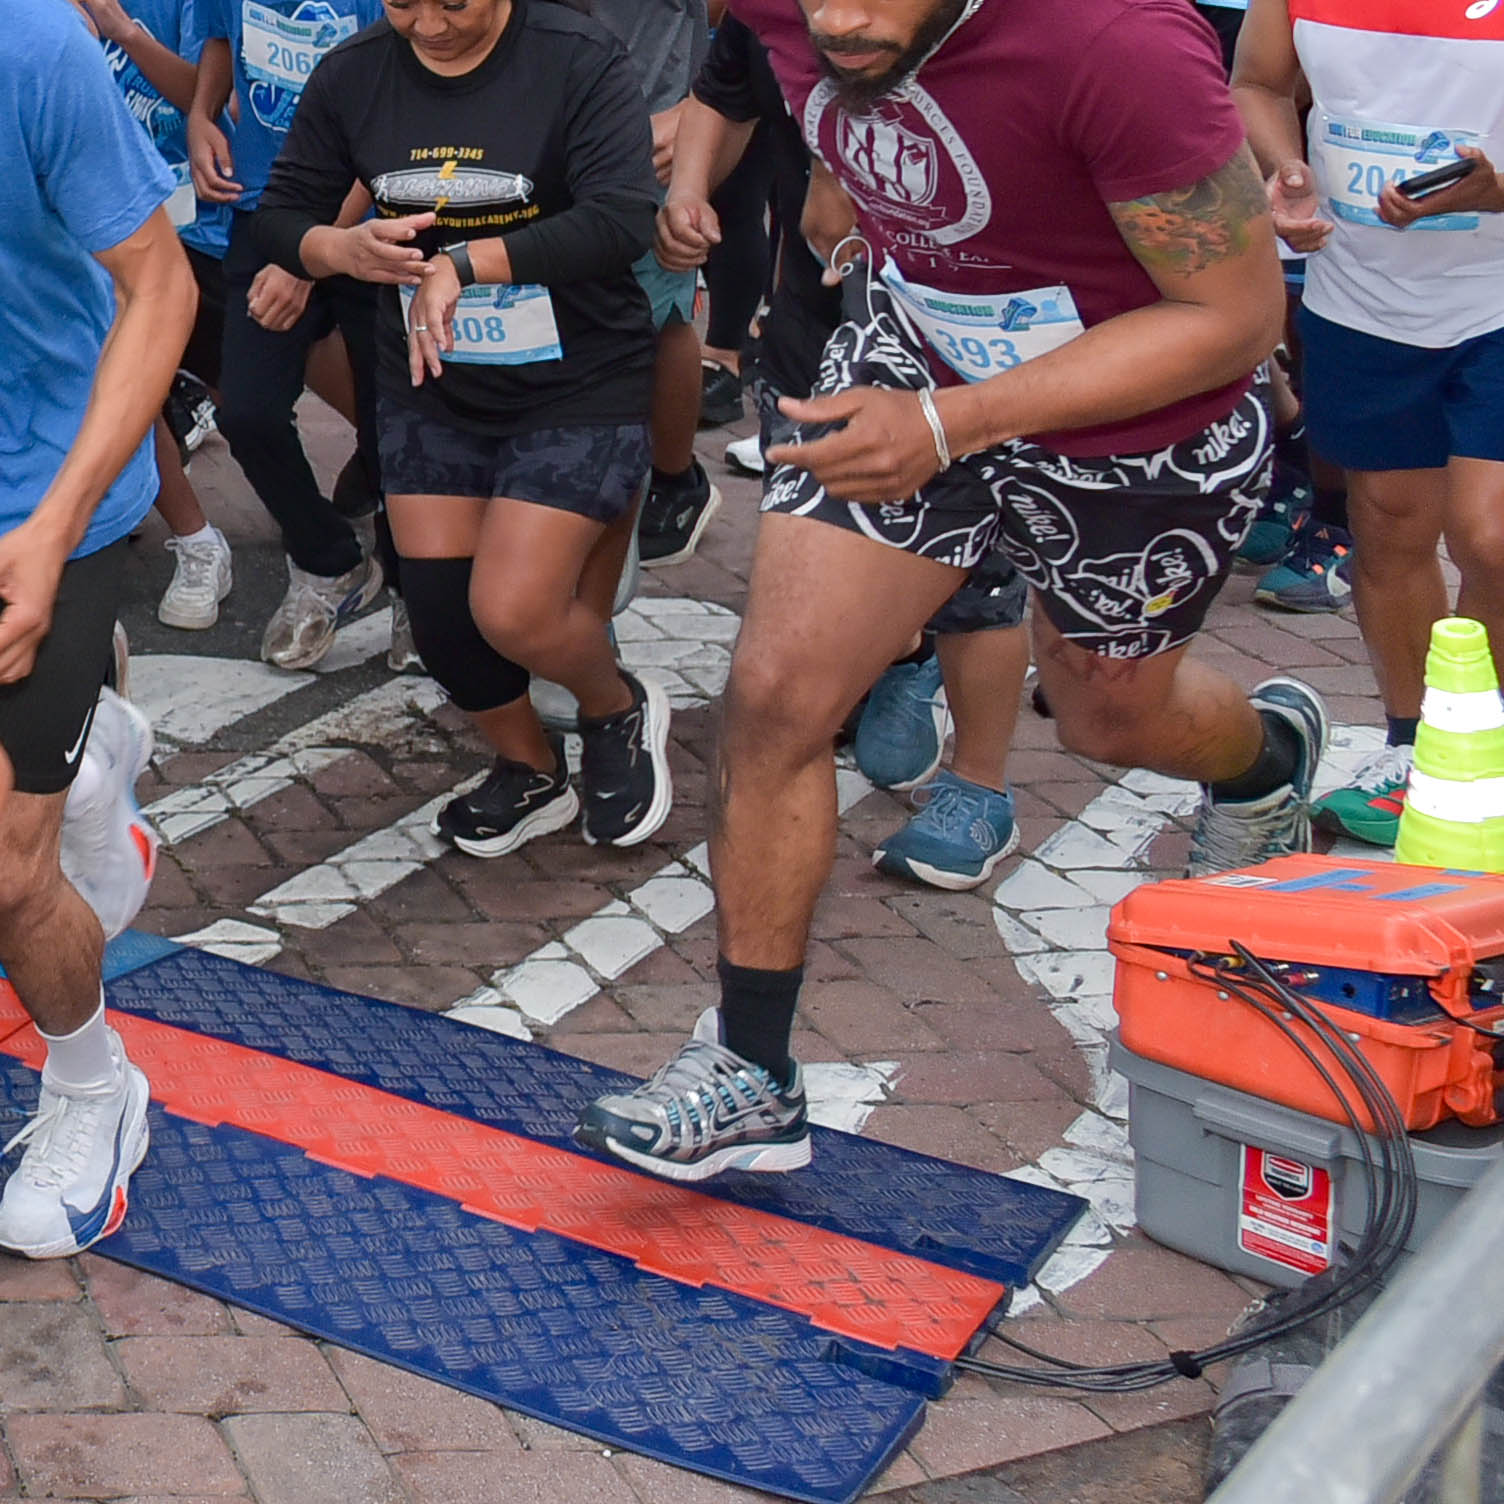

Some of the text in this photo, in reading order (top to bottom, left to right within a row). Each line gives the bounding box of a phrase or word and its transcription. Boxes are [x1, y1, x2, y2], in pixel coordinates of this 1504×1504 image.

[1347, 161, 1428, 196] 204
[935, 328, 1023, 371] 393
[1192, 407, 1253, 466] nike!
[1007, 493, 1071, 544] nike!
